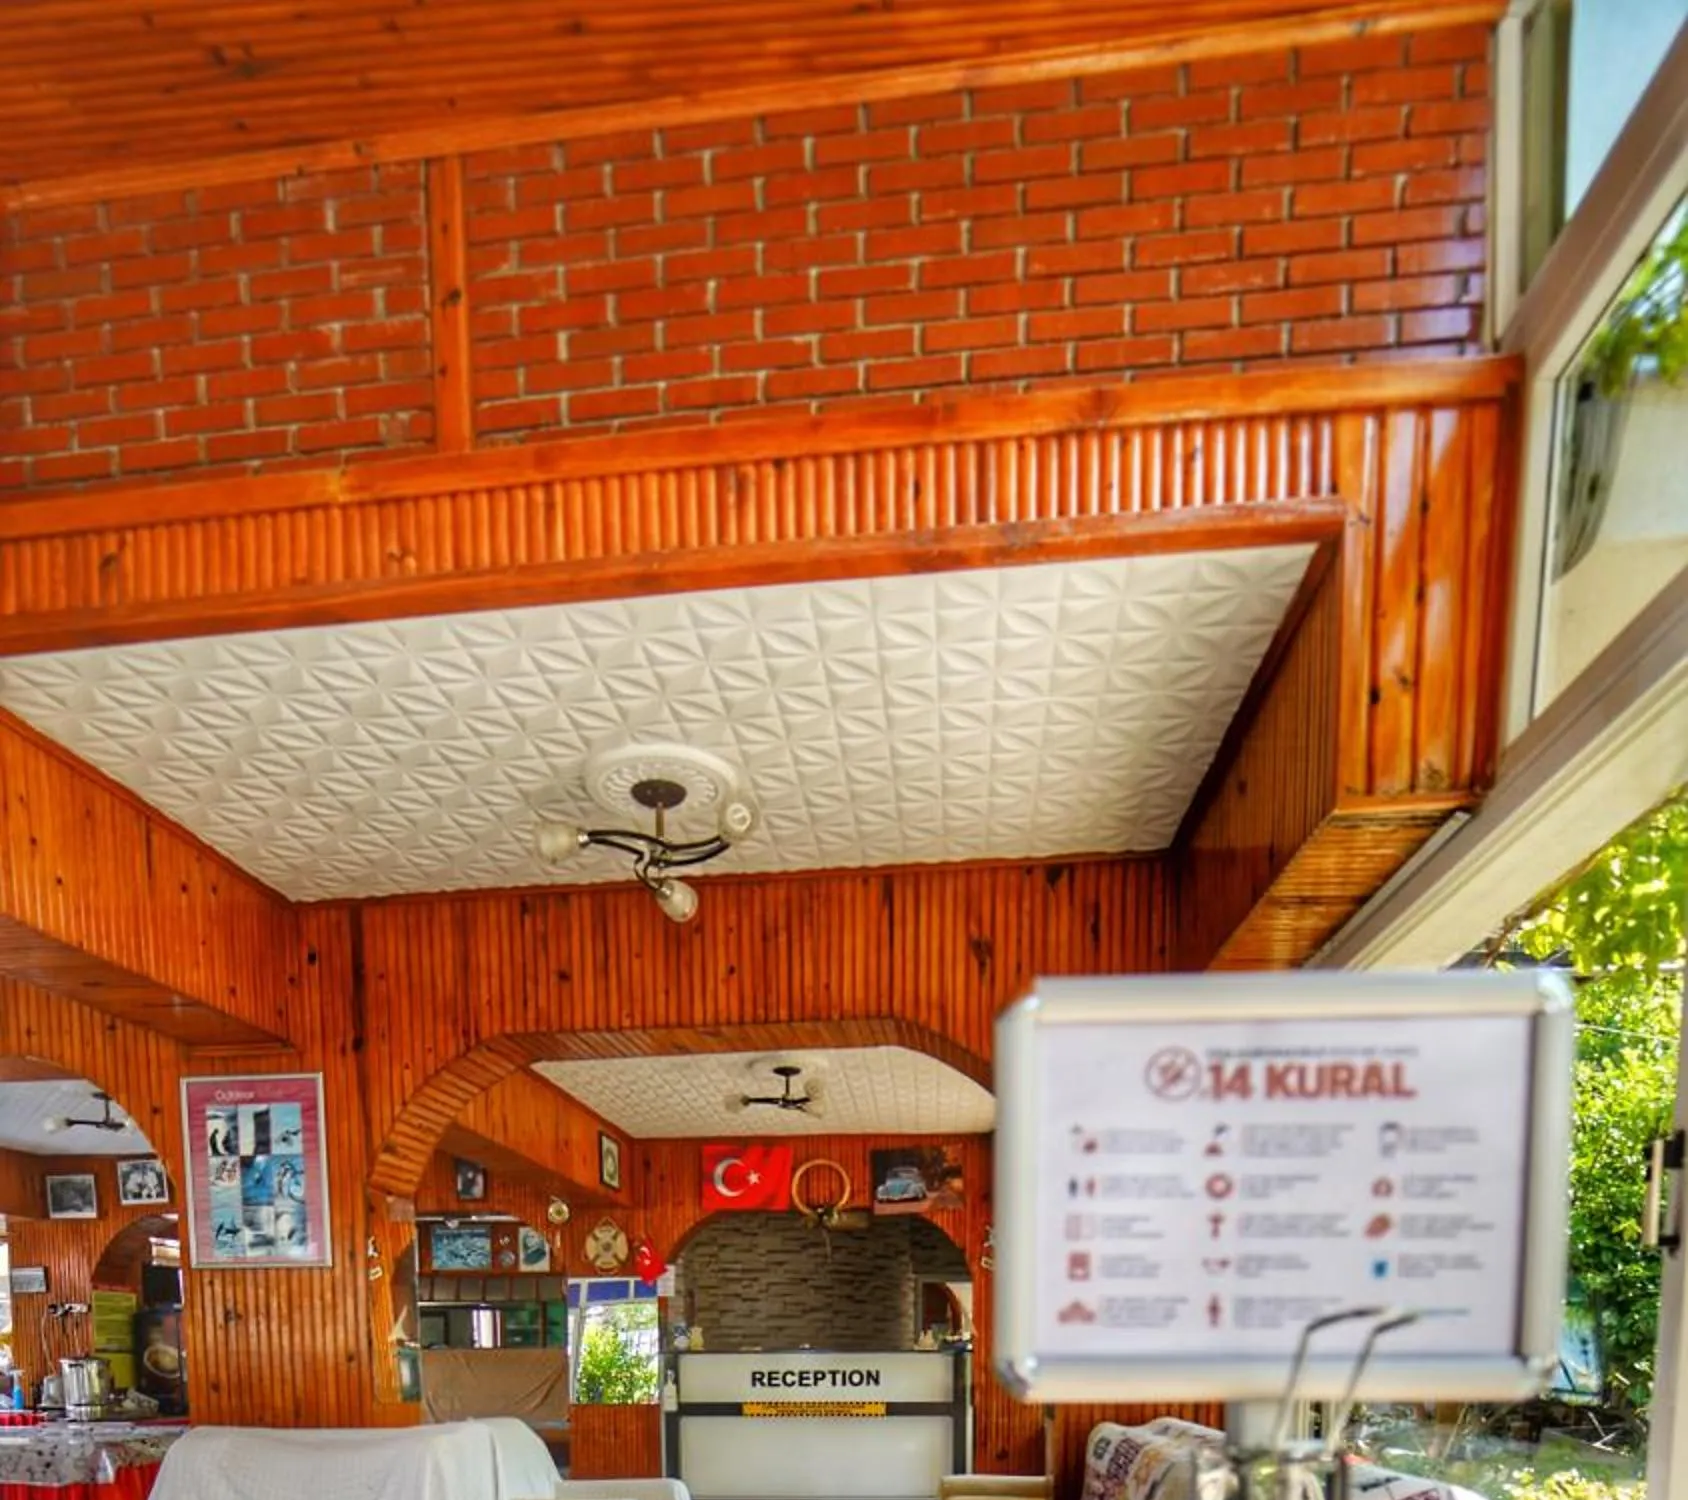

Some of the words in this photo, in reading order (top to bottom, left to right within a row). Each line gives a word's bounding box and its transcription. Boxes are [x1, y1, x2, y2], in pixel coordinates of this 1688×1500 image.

[1209, 1059, 1252, 1099] 14
[1264, 1059, 1418, 1099] KURAL
[751, 1370, 881, 1387] RECEPTION
